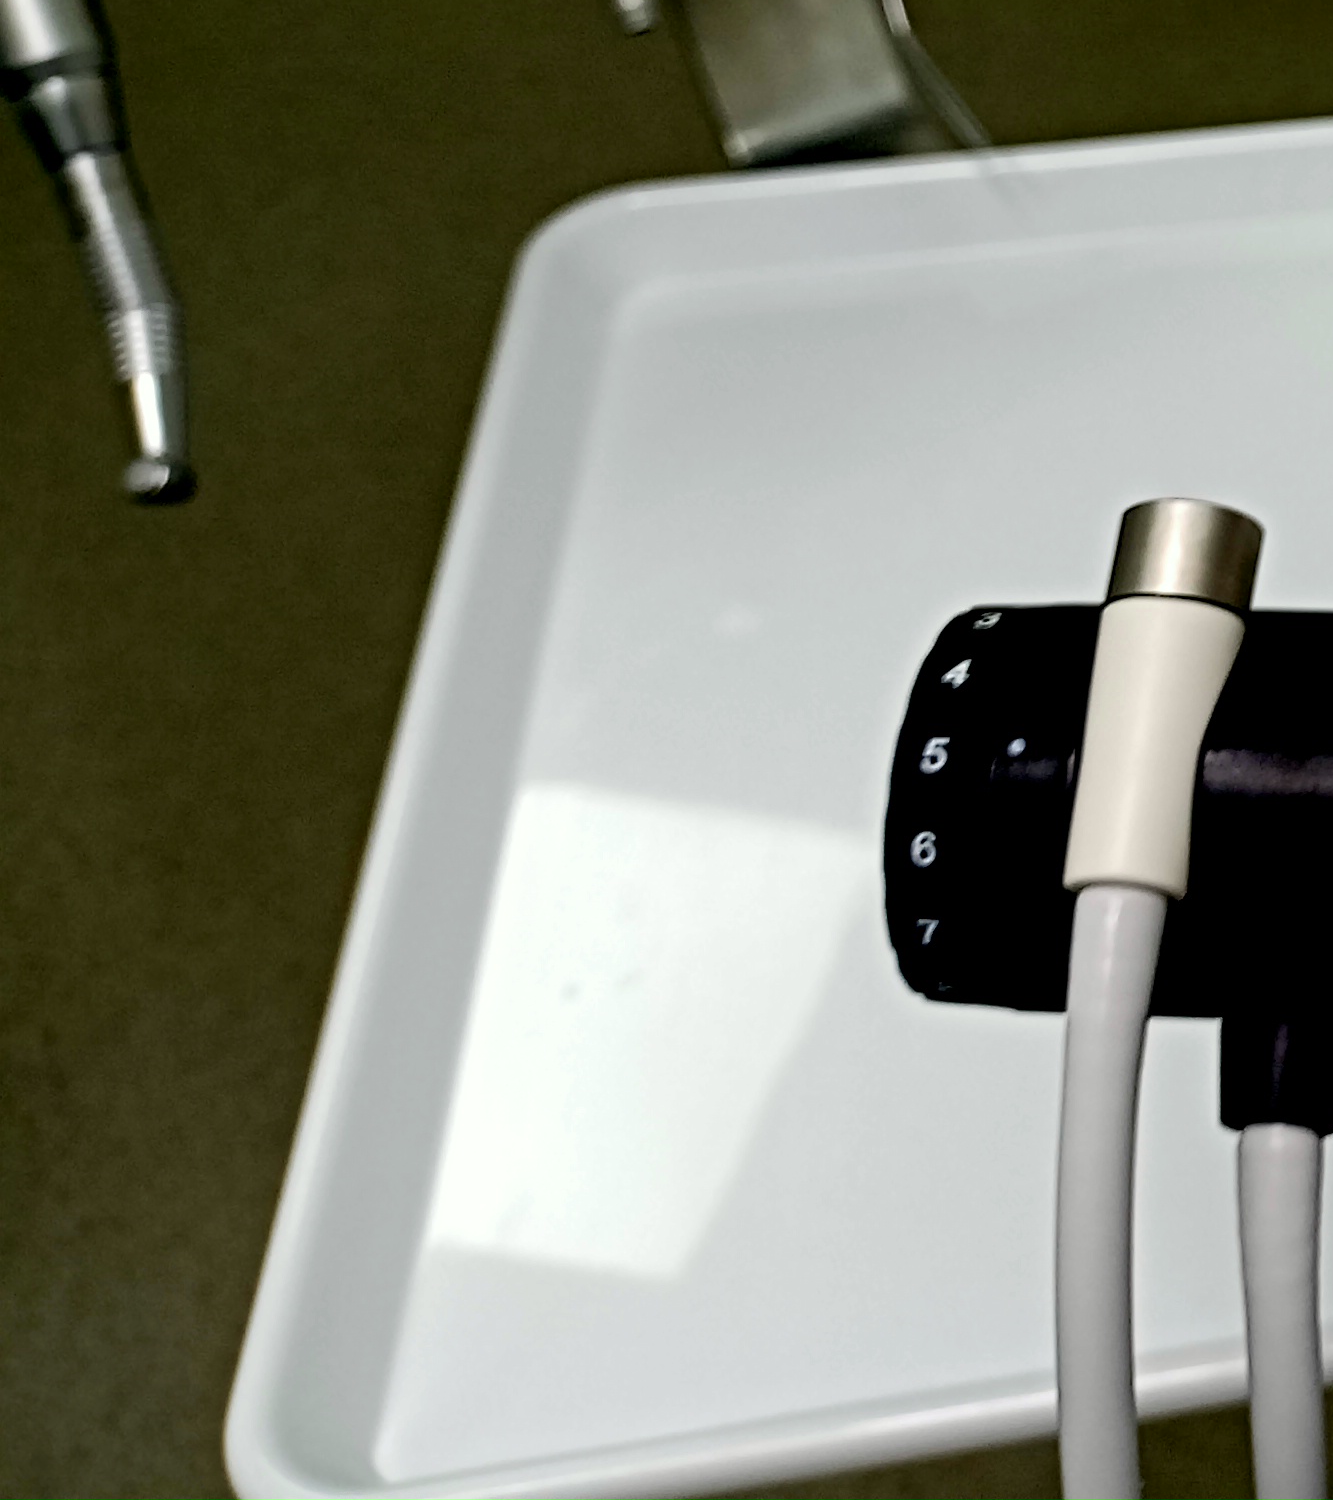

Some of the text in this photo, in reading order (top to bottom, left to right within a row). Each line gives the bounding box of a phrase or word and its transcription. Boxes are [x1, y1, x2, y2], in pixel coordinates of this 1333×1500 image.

[940, 658, 973, 689] 4
[919, 736, 951, 774] 5
[910, 830, 937, 868] 6
[917, 918, 940, 945] 7
